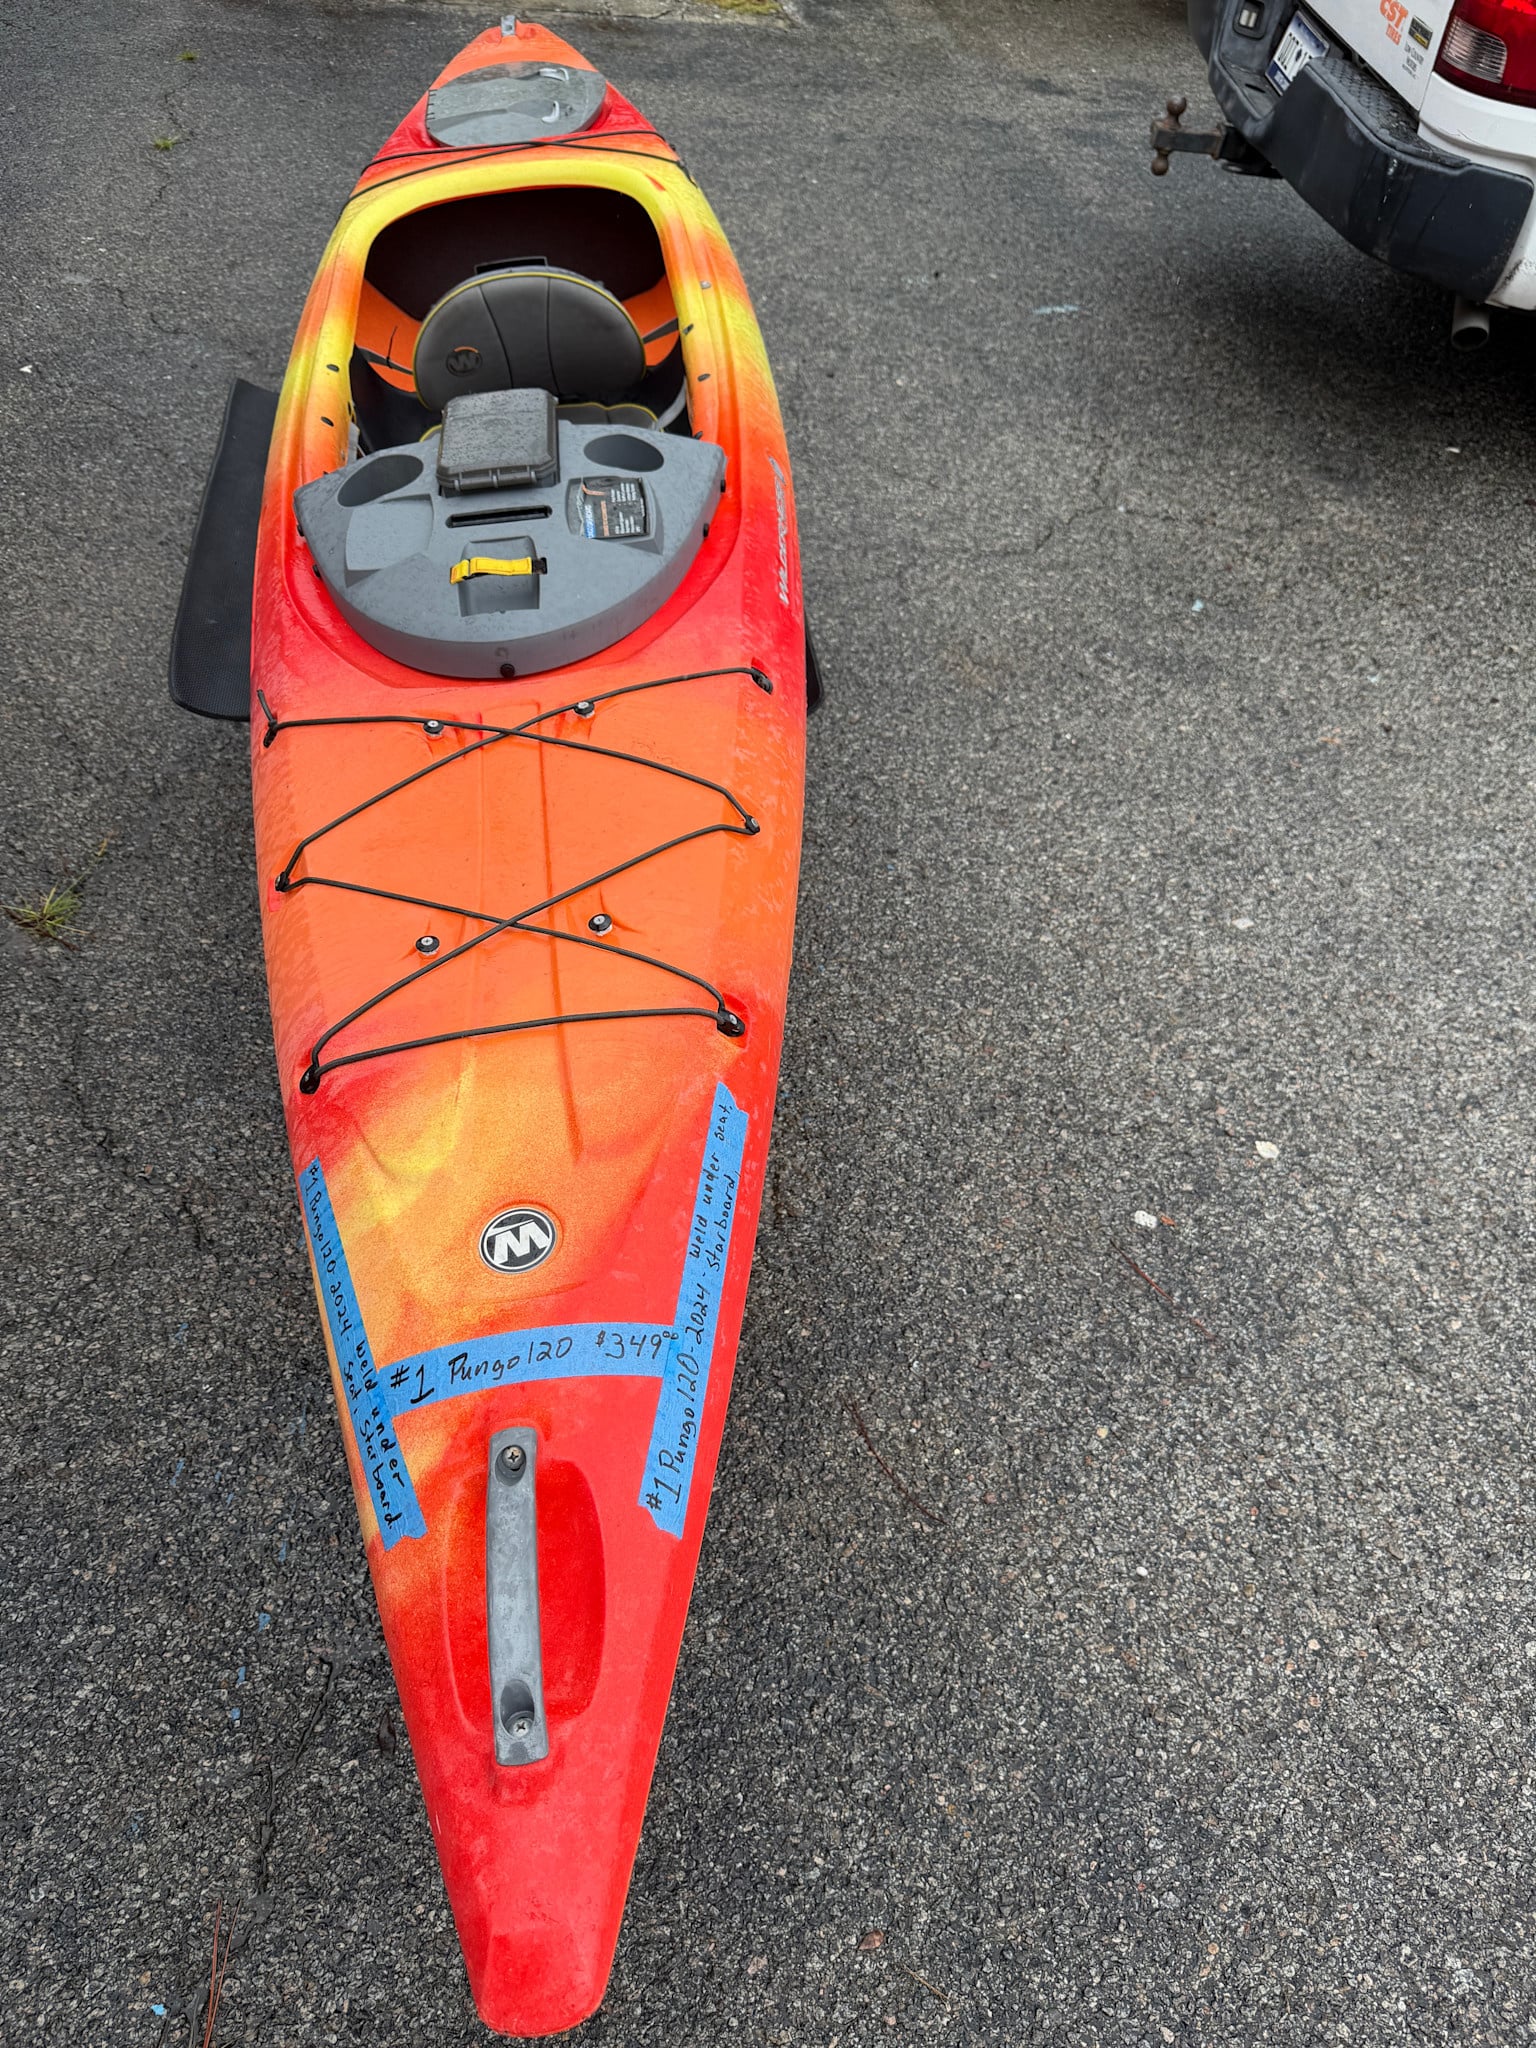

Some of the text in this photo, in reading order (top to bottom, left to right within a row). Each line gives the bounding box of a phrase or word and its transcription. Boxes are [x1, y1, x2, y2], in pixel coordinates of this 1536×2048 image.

[1379, 0, 1408, 29] CST
[305, 1164, 320, 1195] #1
[371, 1405, 405, 1487] under
[390, 1364, 435, 1404] #1
[646, 1476, 682, 1511] #1
[702, 1153, 720, 1205] under
